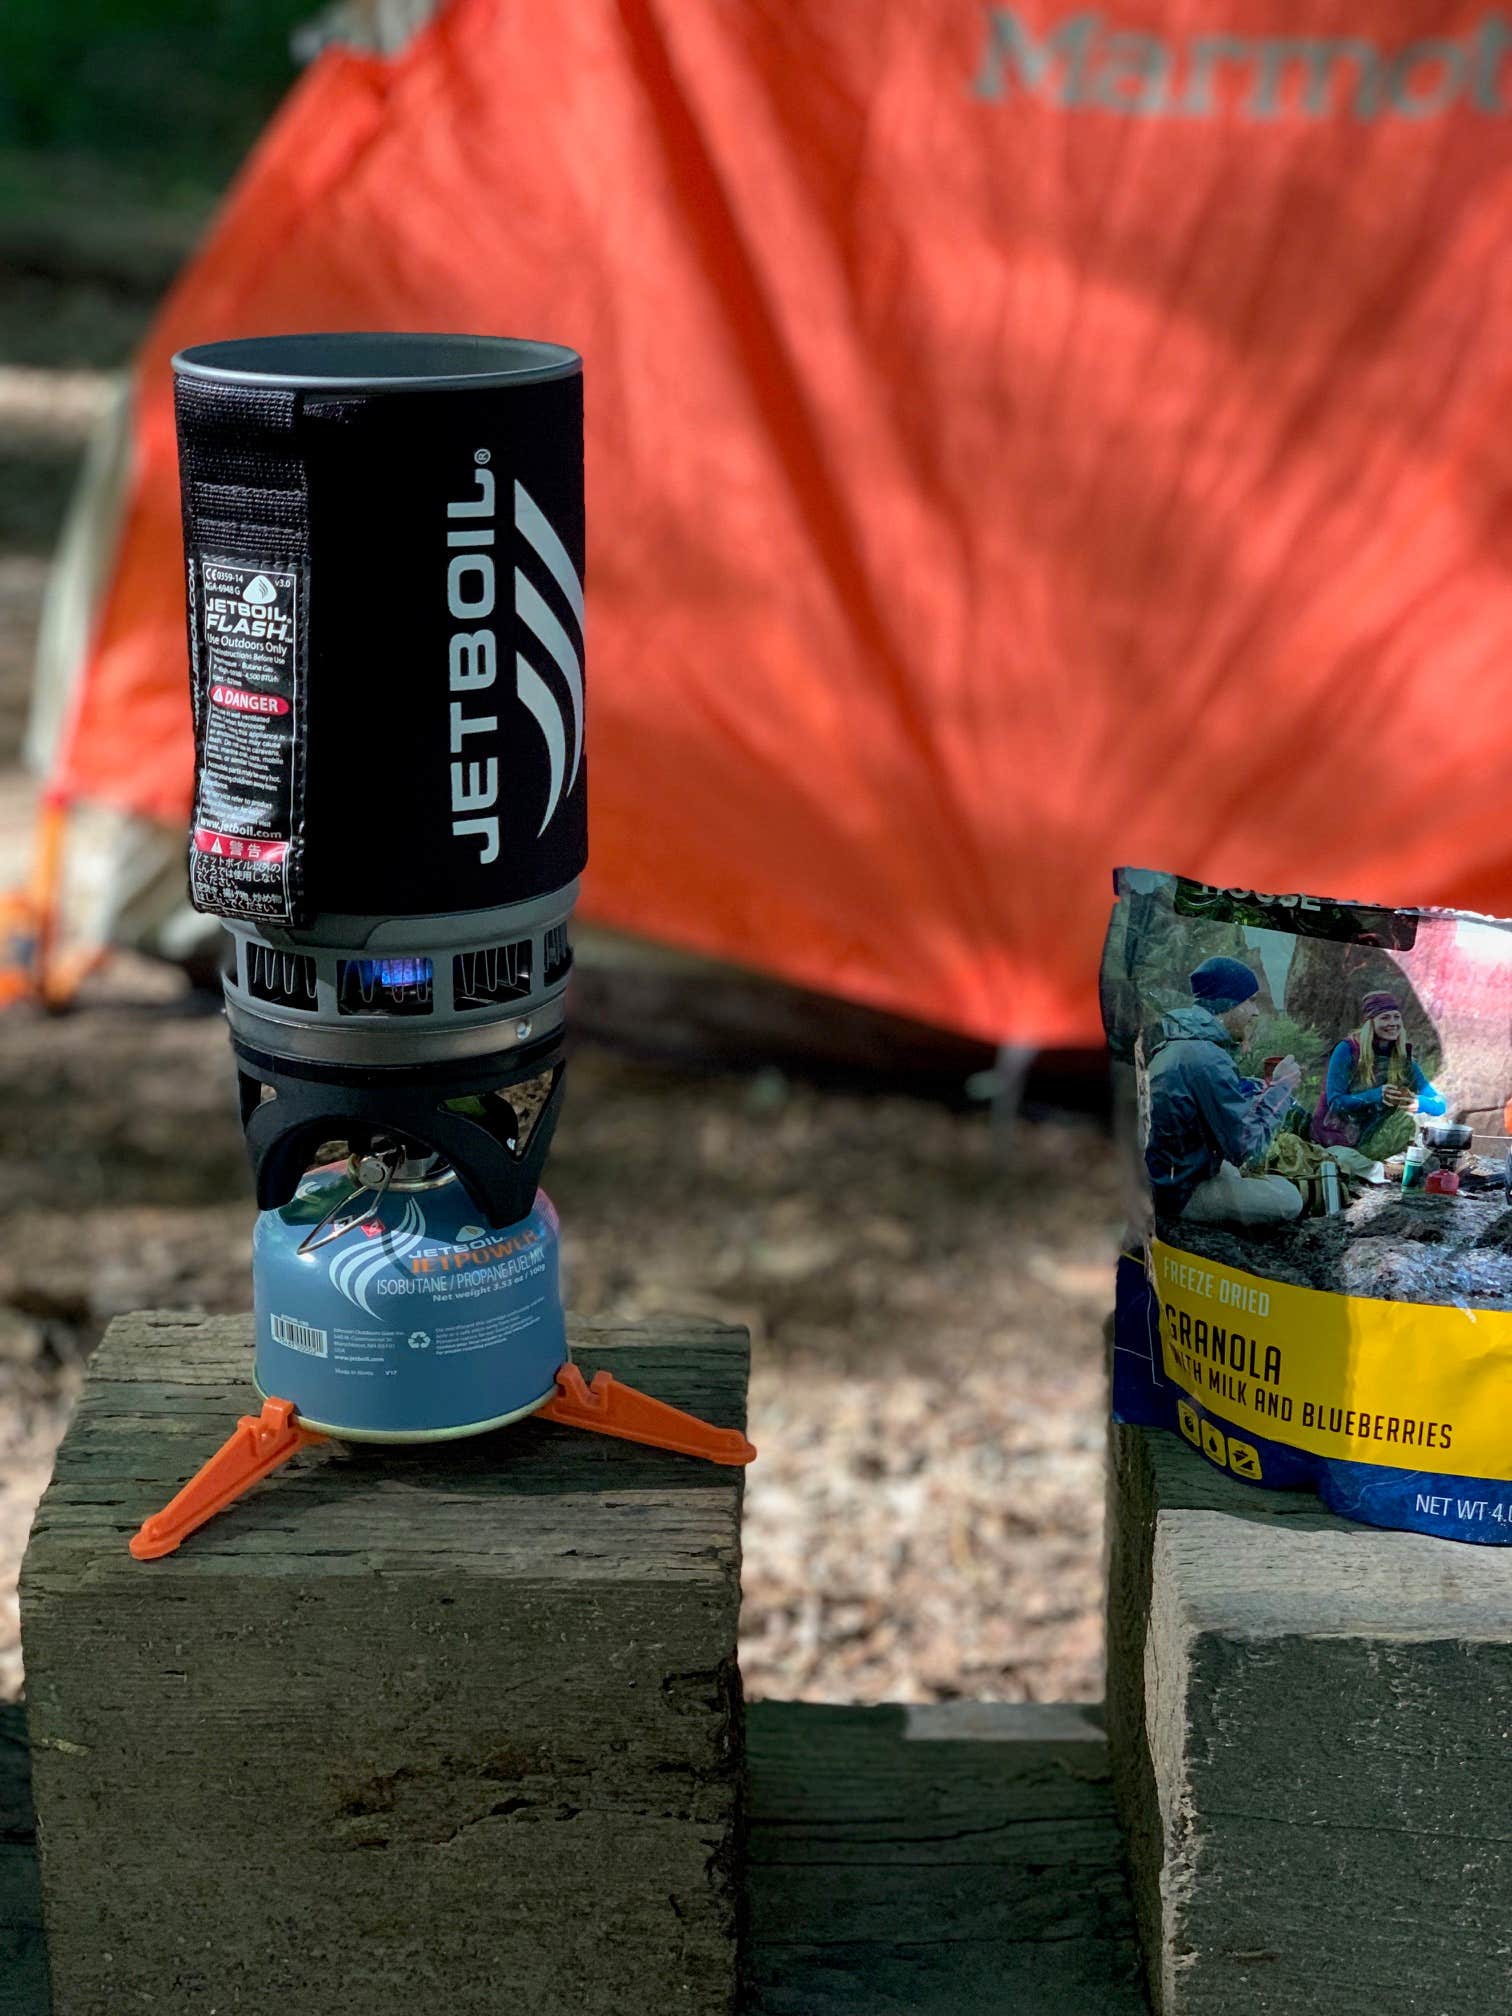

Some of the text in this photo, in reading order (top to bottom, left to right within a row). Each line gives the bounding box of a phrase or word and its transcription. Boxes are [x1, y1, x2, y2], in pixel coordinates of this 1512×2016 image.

[275, 579, 291, 588] v3.0
[221, 636, 264, 651] Outdoors
[266, 642, 287, 657] Only
[274, 656, 285, 665] Use
[225, 690, 278, 712] DANGER
[200, 817, 282, 838] www.jetboil.com
[409, 1235, 504, 1258] JETBOIL
[377, 1276, 447, 1295] ISOBUTANE
[457, 1264, 507, 1289] PROPANE
[507, 1256, 531, 1277] FUEL
[433, 1293, 452, 1302] Net
[455, 1286, 491, 1300] weight
[1163, 1256, 1270, 1318] FREEZE DRIED
[1165, 1304, 1282, 1386] GRANOLA
[1169, 1343, 1454, 1450] WITH MILK AND BLUEBERRIES
[1415, 1493, 1454, 1517] NET
[1457, 1499, 1489, 1521] WT
